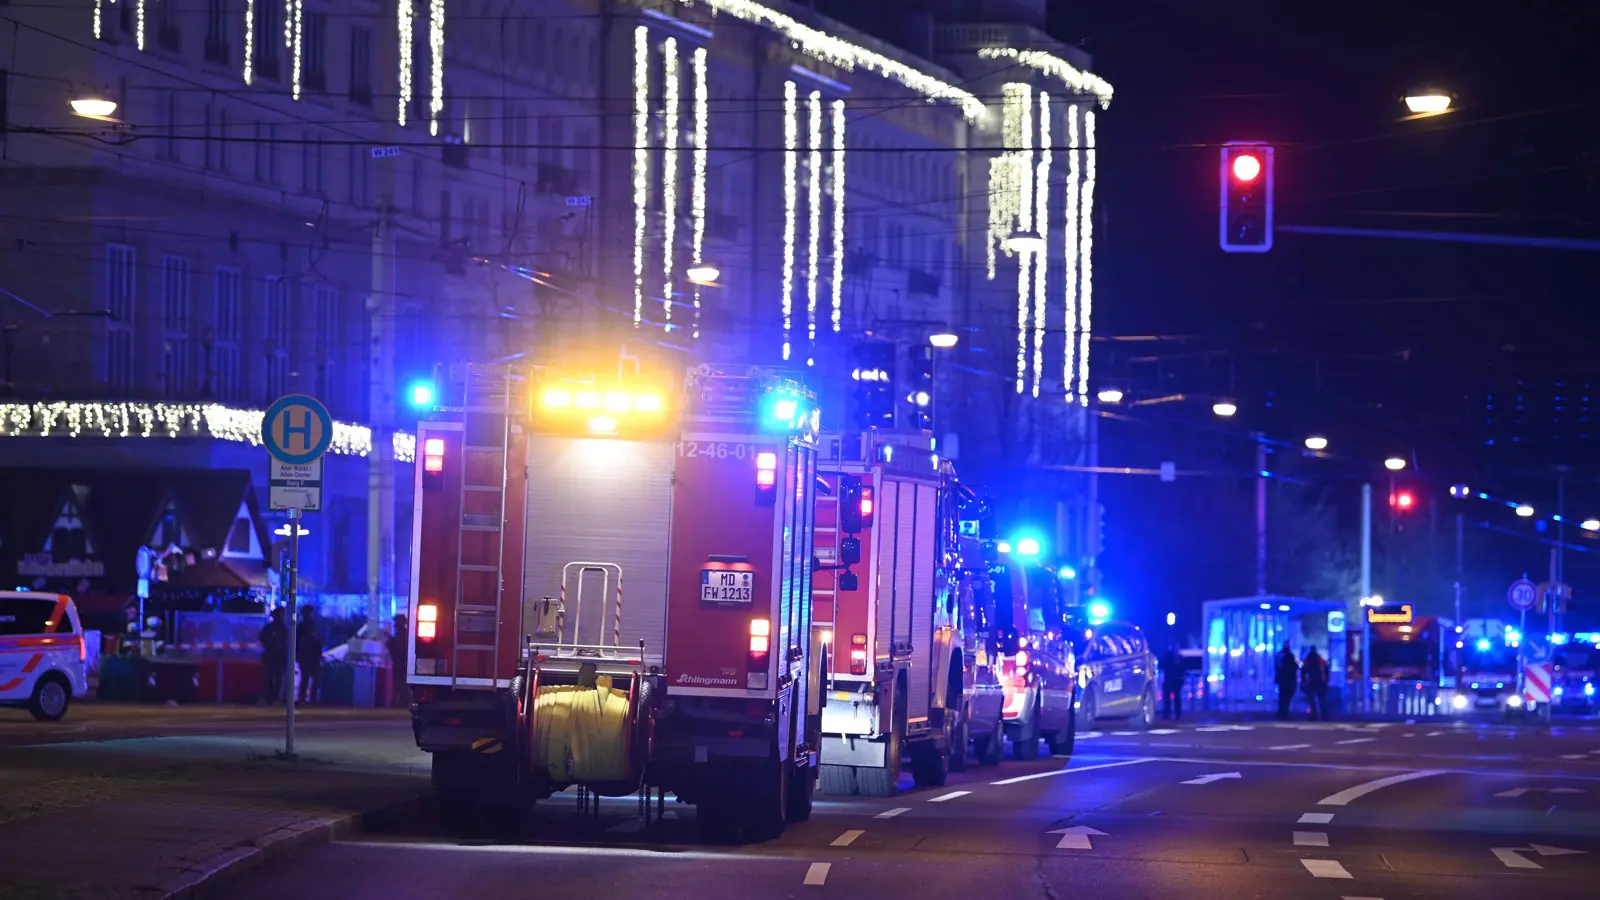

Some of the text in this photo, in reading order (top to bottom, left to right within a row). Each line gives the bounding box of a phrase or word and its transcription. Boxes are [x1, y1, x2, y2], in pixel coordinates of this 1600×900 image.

[283, 411, 311, 449] H
[676, 441, 756, 460] 12-46-01
[286, 479, 300, 487] Steig
[720, 573, 736, 586] MD
[704, 586, 750, 600] FW 1213
[676, 673, 738, 685] Schlingmann
